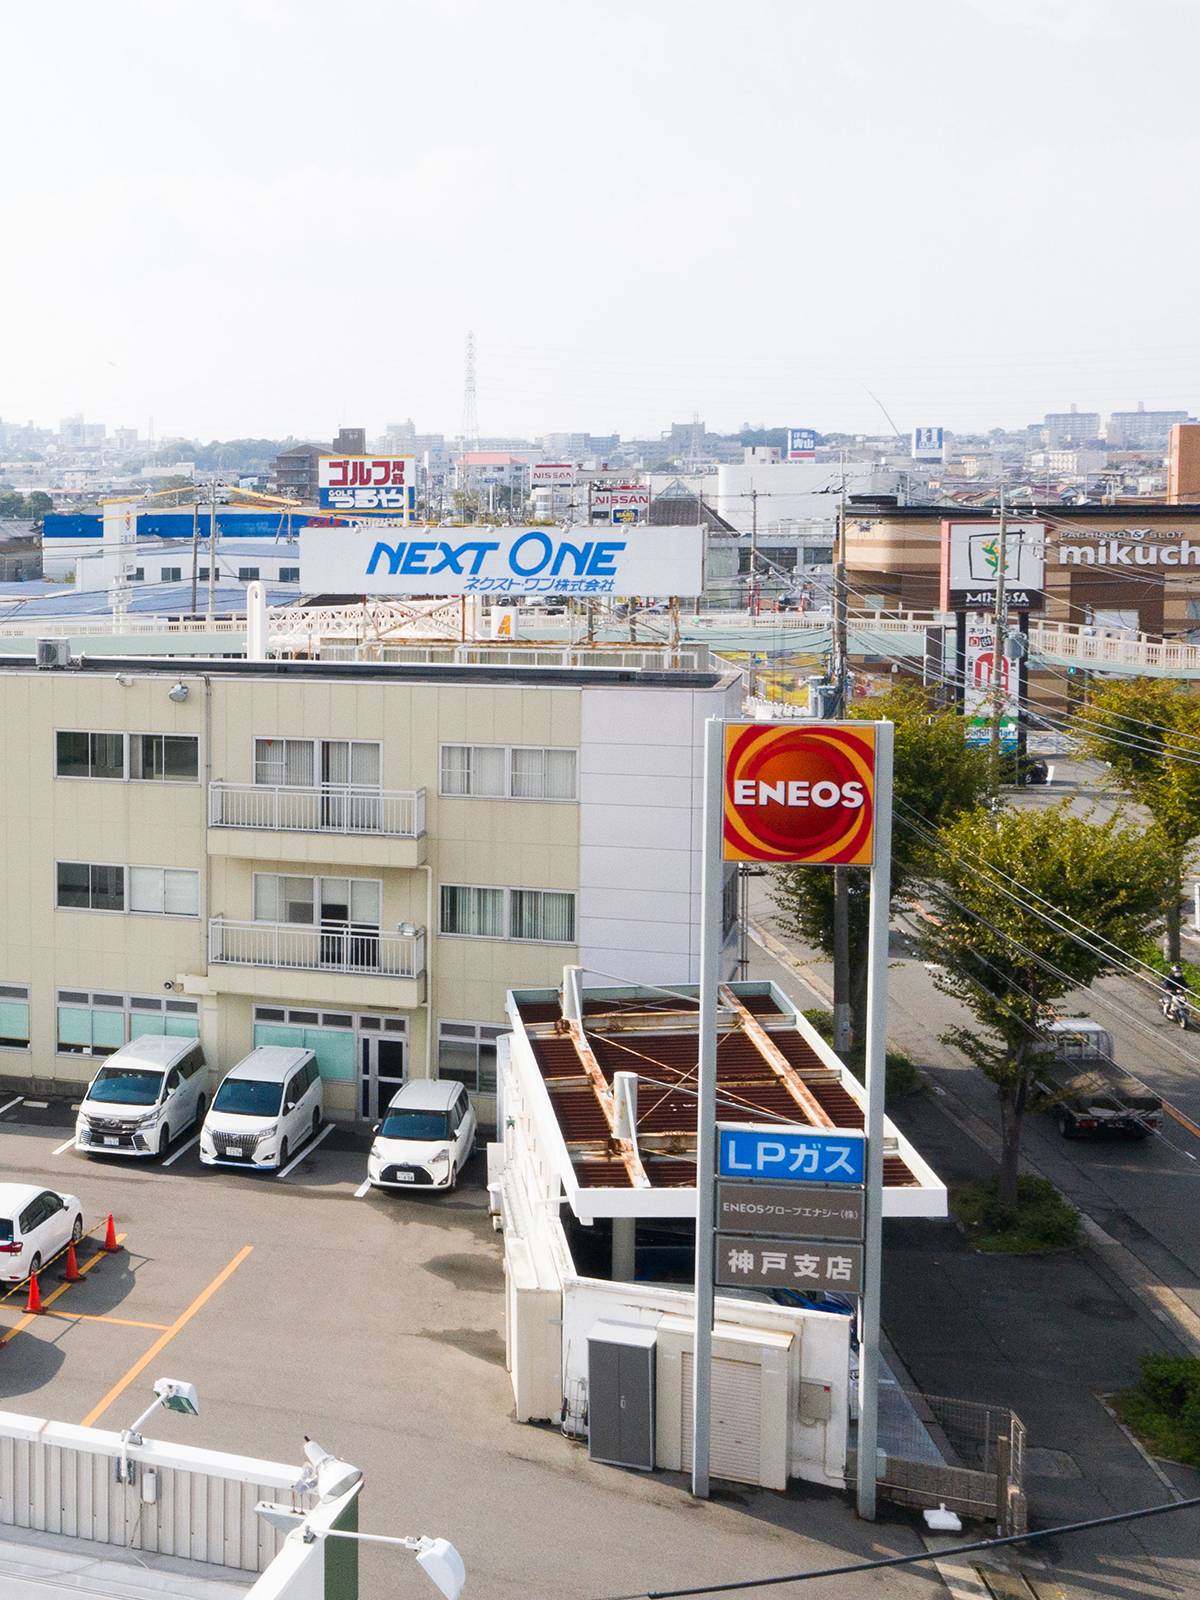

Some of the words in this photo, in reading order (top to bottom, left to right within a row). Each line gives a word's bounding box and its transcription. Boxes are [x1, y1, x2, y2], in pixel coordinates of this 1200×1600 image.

[595, 496, 649, 504] NISSAN
[366, 542, 500, 575] NEXT
[509, 531, 627, 576] ONE
[464, 577, 615, 592] ネクスト・ワン株式会社
[734, 780, 864, 808] ENEOS
[728, 1140, 856, 1175] LPガス
[728, 1249, 853, 1282] 神戸支店
